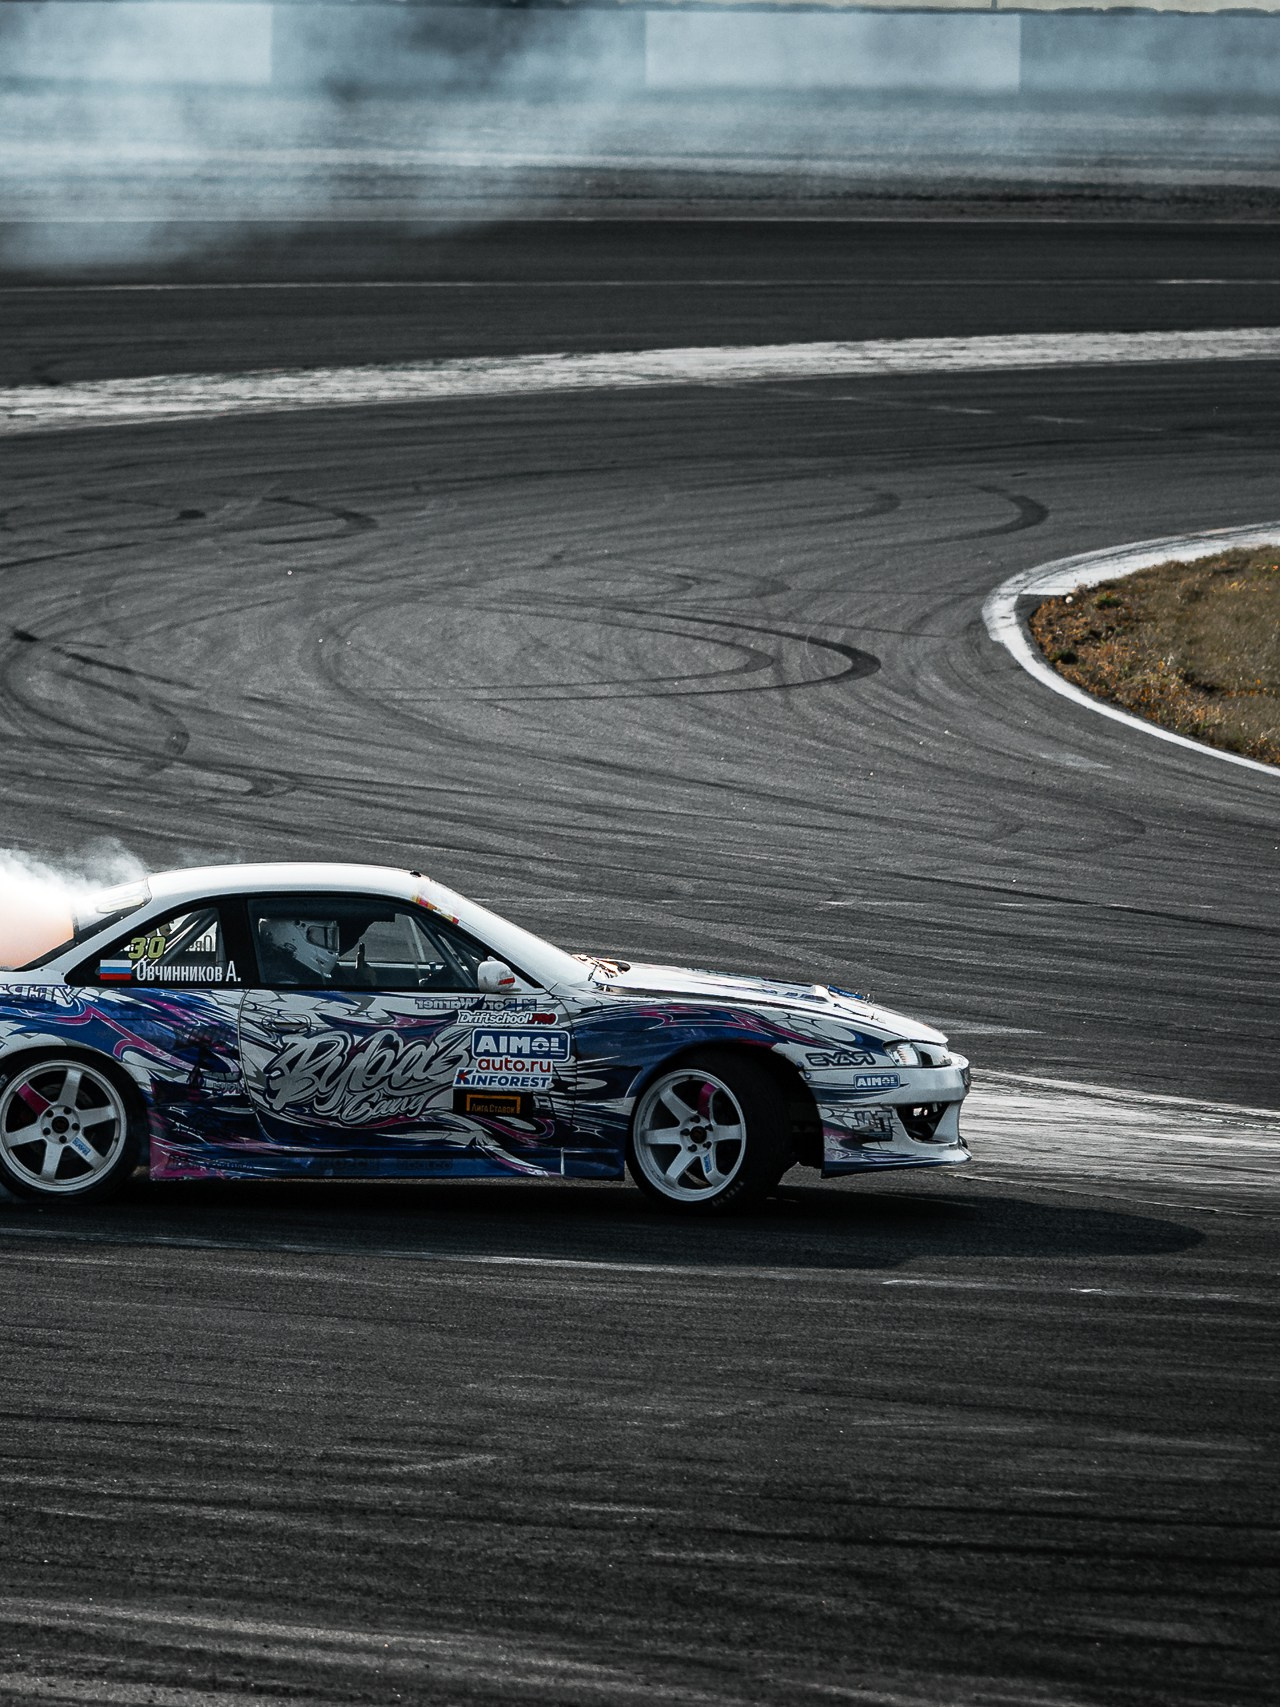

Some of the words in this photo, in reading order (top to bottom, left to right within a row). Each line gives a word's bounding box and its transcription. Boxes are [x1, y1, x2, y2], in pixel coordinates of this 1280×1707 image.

[128, 936, 166, 959] 30
[136, 960, 223, 982] Овчинников
[476, 1035, 565, 1055] AIMOL
[477, 1057, 551, 1072] auto.ru
[455, 1069, 550, 1087] KINFOREST
[856, 1077, 897, 1087] AIMOL
